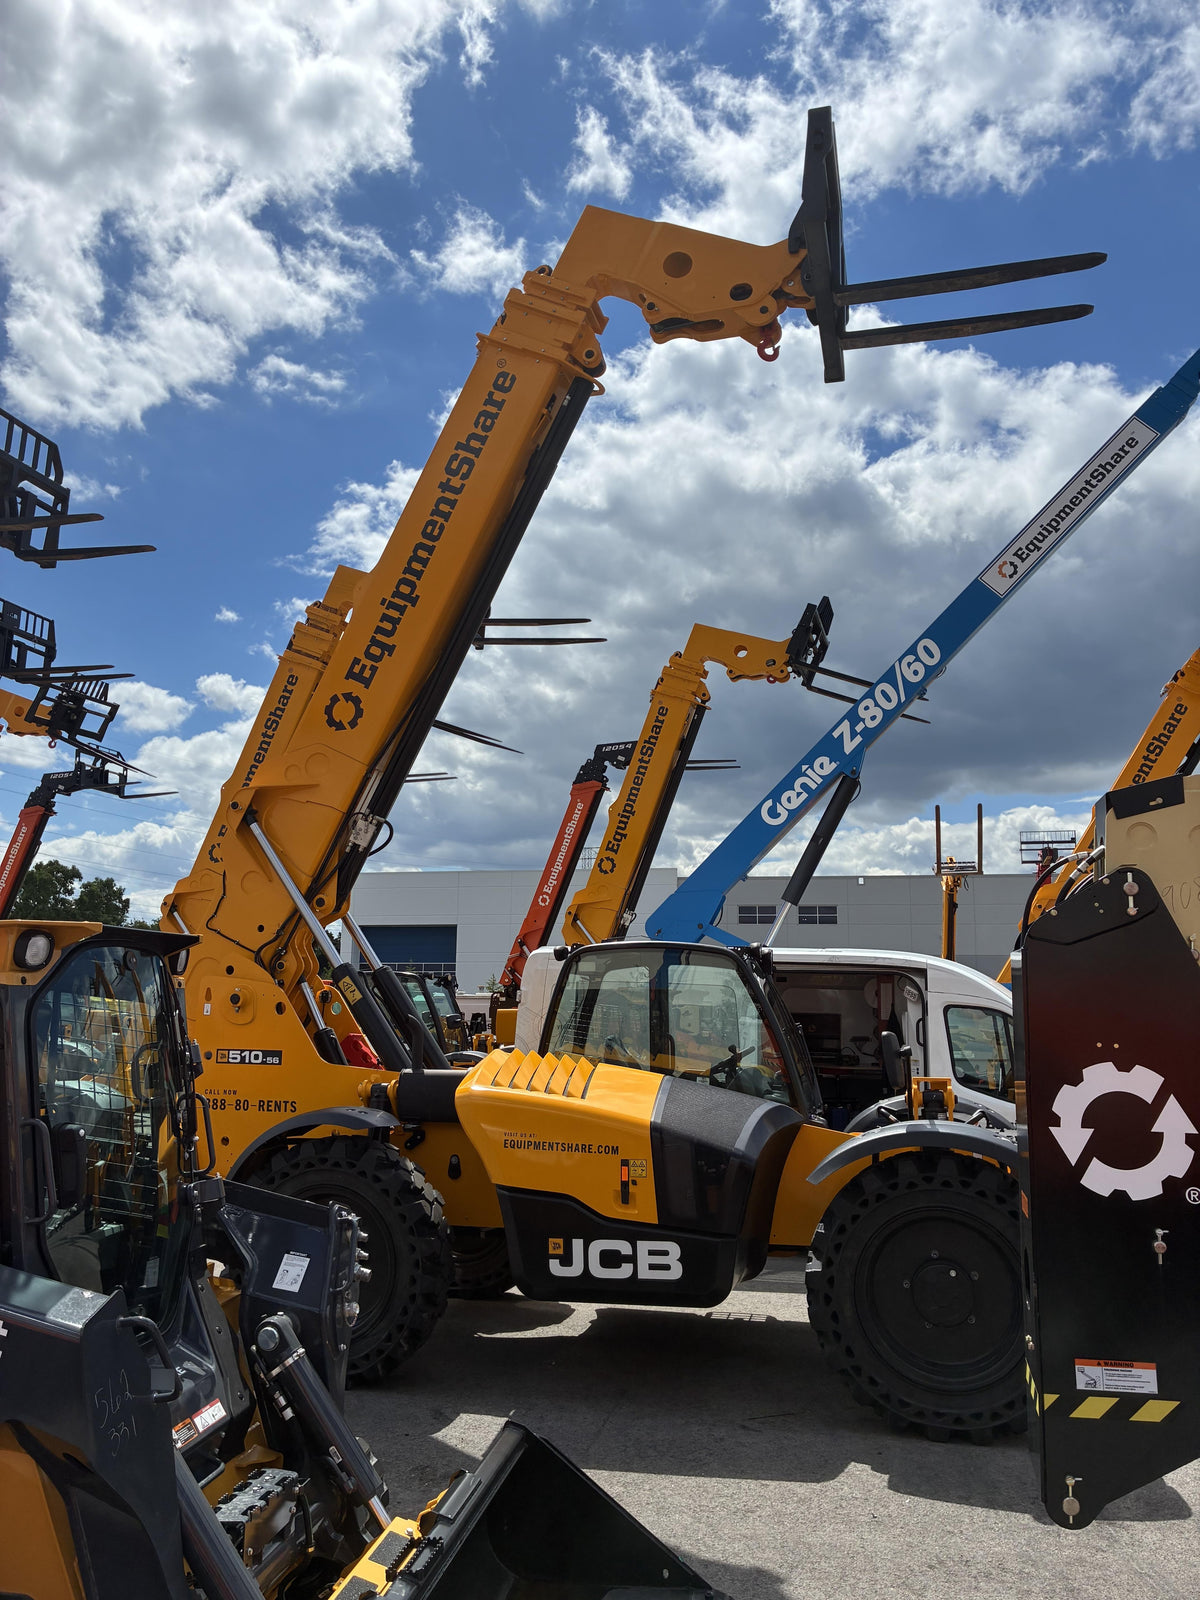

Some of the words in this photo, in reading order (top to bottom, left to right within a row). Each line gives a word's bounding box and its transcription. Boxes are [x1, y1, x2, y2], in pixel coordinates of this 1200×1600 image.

[345, 369, 517, 689] EquipmentShare
[1012, 436, 1139, 563] EquipmentShare
[832, 638, 941, 755] Z-80/60
[606, 705, 669, 855] EquipmentShare
[760, 756, 838, 826] Genie
[543, 802, 584, 894] EquipmentShare
[204, 1088, 220, 1096] CALL
[503, 1139, 619, 1156] EQUIPMENTSHARE.COM
[548, 1238, 683, 1280] JCB
